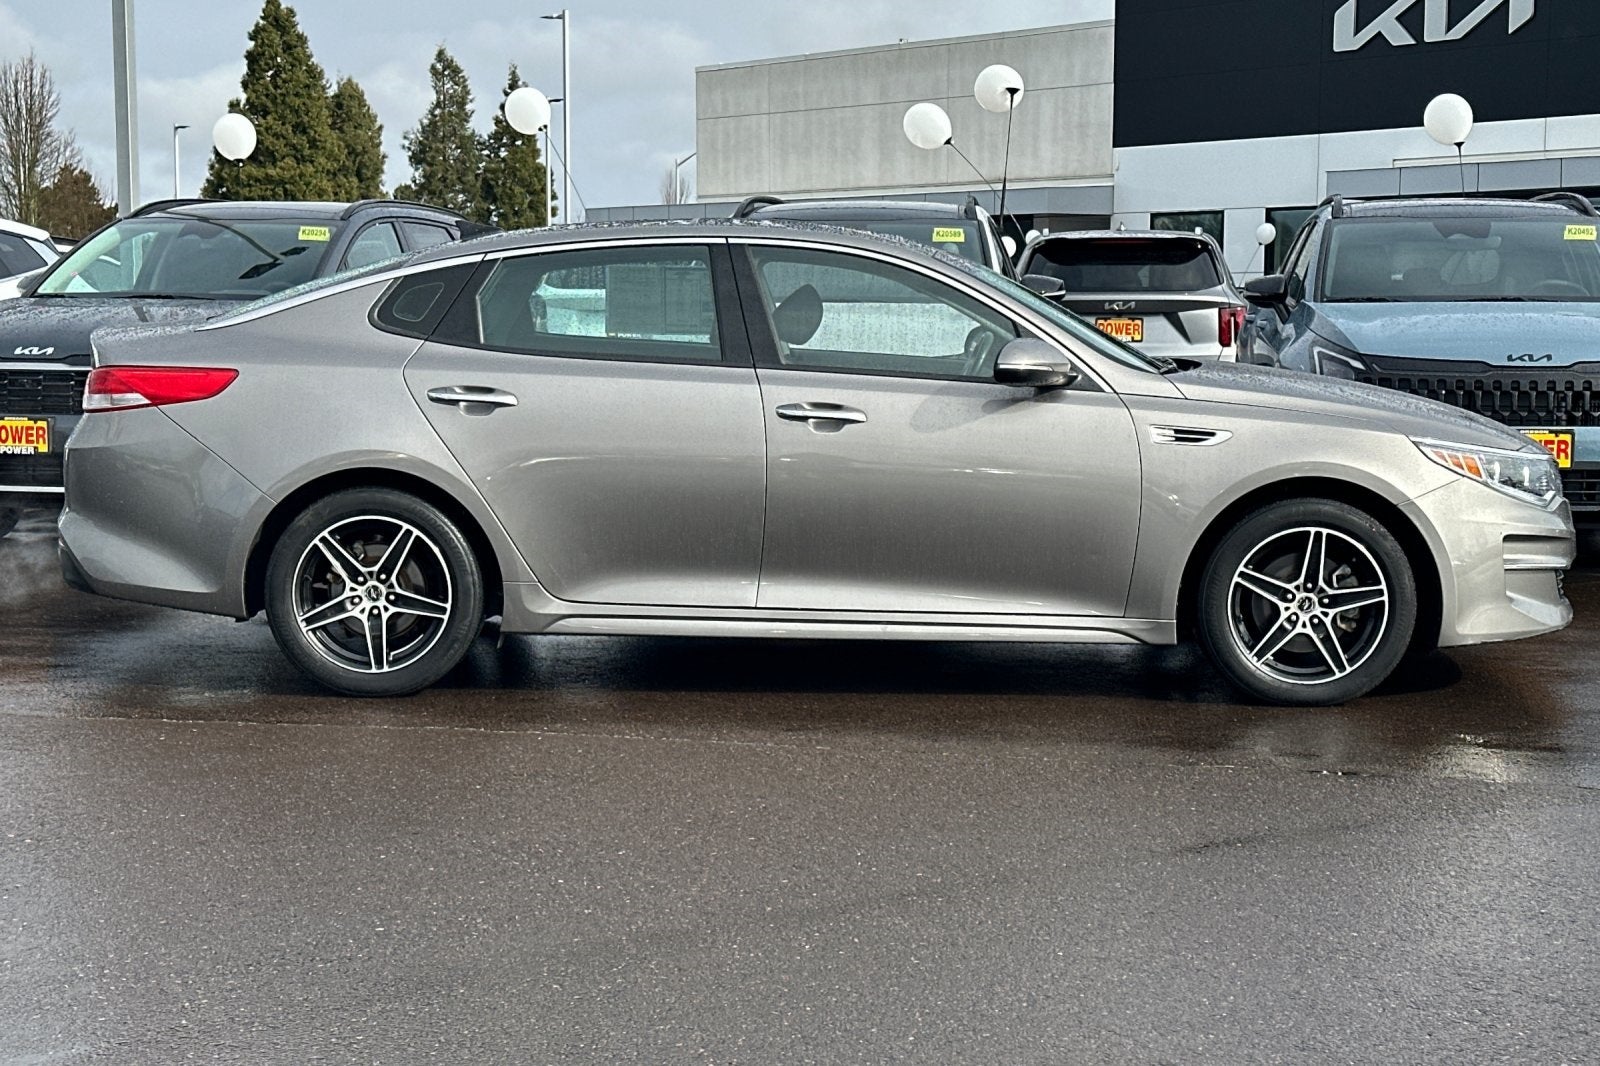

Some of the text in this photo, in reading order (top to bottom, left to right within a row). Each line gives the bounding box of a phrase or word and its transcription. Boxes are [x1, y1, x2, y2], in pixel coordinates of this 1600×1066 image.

[14, 346, 54, 355] KIA
[1507, 354, 1552, 362] KIA
[0, 425, 47, 445] OWER
